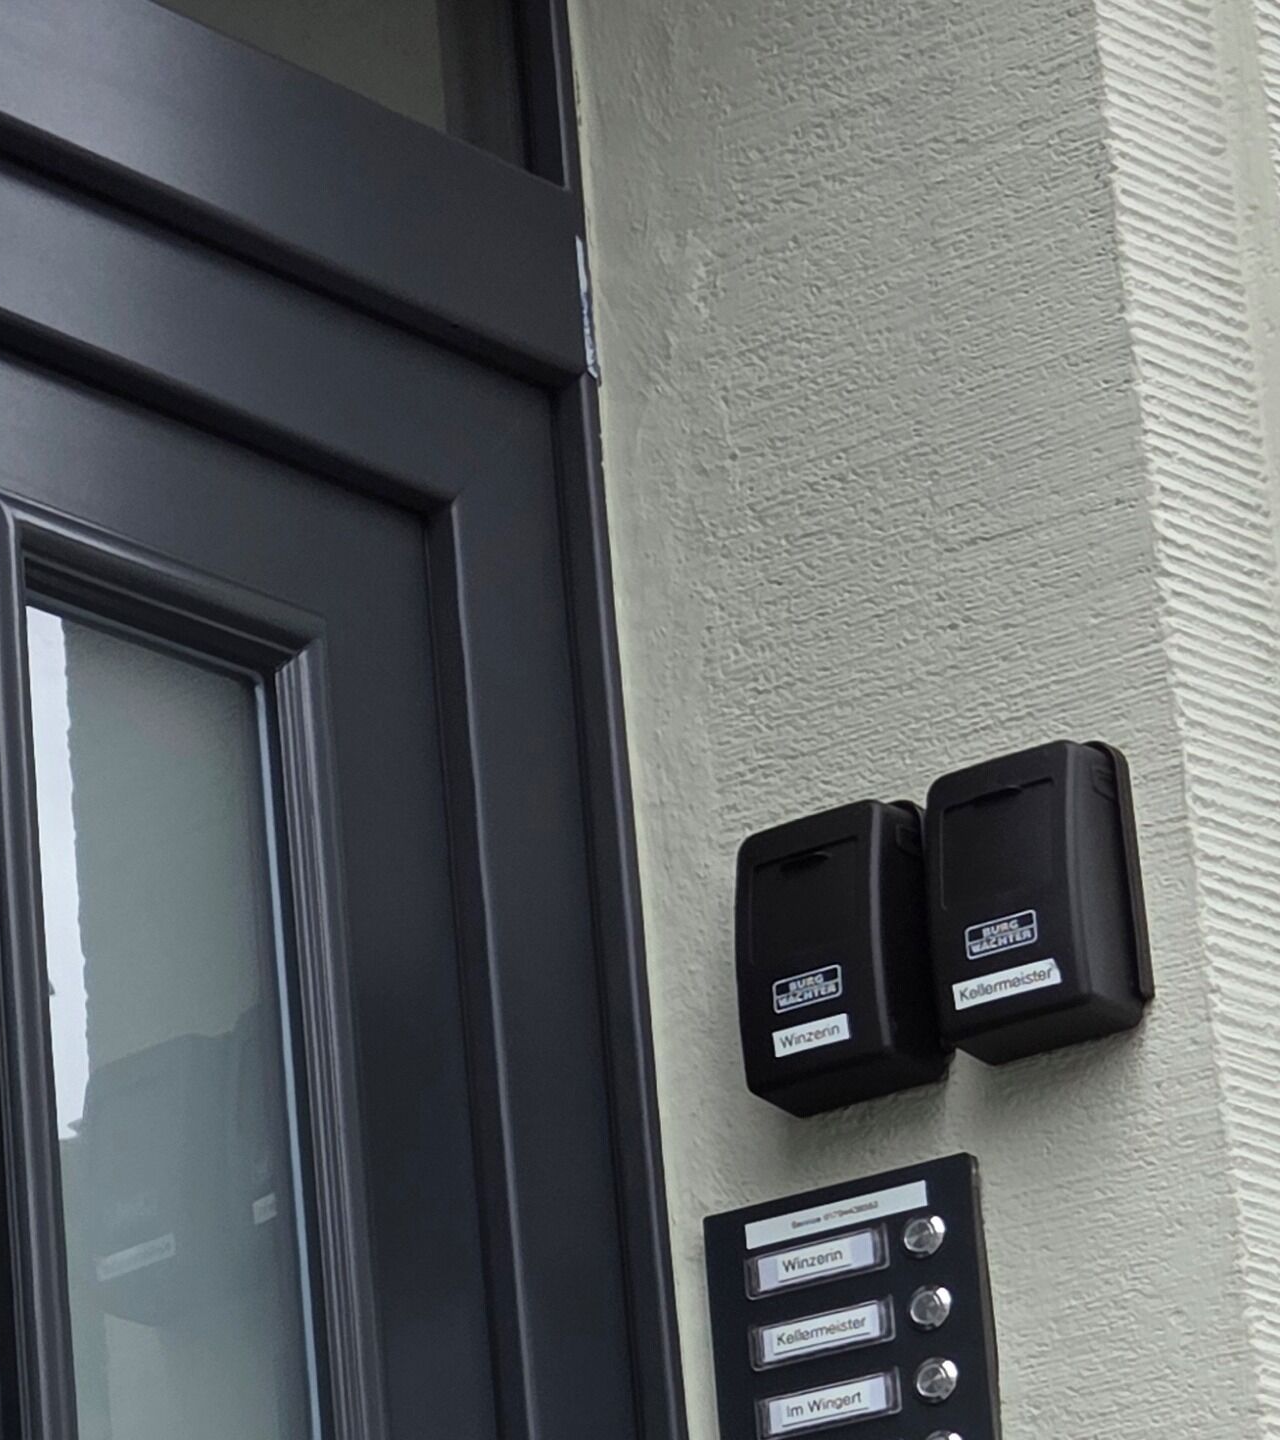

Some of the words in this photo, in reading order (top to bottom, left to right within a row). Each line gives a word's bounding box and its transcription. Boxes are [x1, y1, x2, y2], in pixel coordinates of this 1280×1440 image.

[959, 967, 1054, 1001] Kellermeister
[780, 1023, 840, 1049] Winzerin
[782, 1250, 843, 1273] Winzerin
[776, 1317, 867, 1348] Kellermeister
[786, 1403, 804, 1418] Im
[807, 1392, 862, 1414] Wingert
